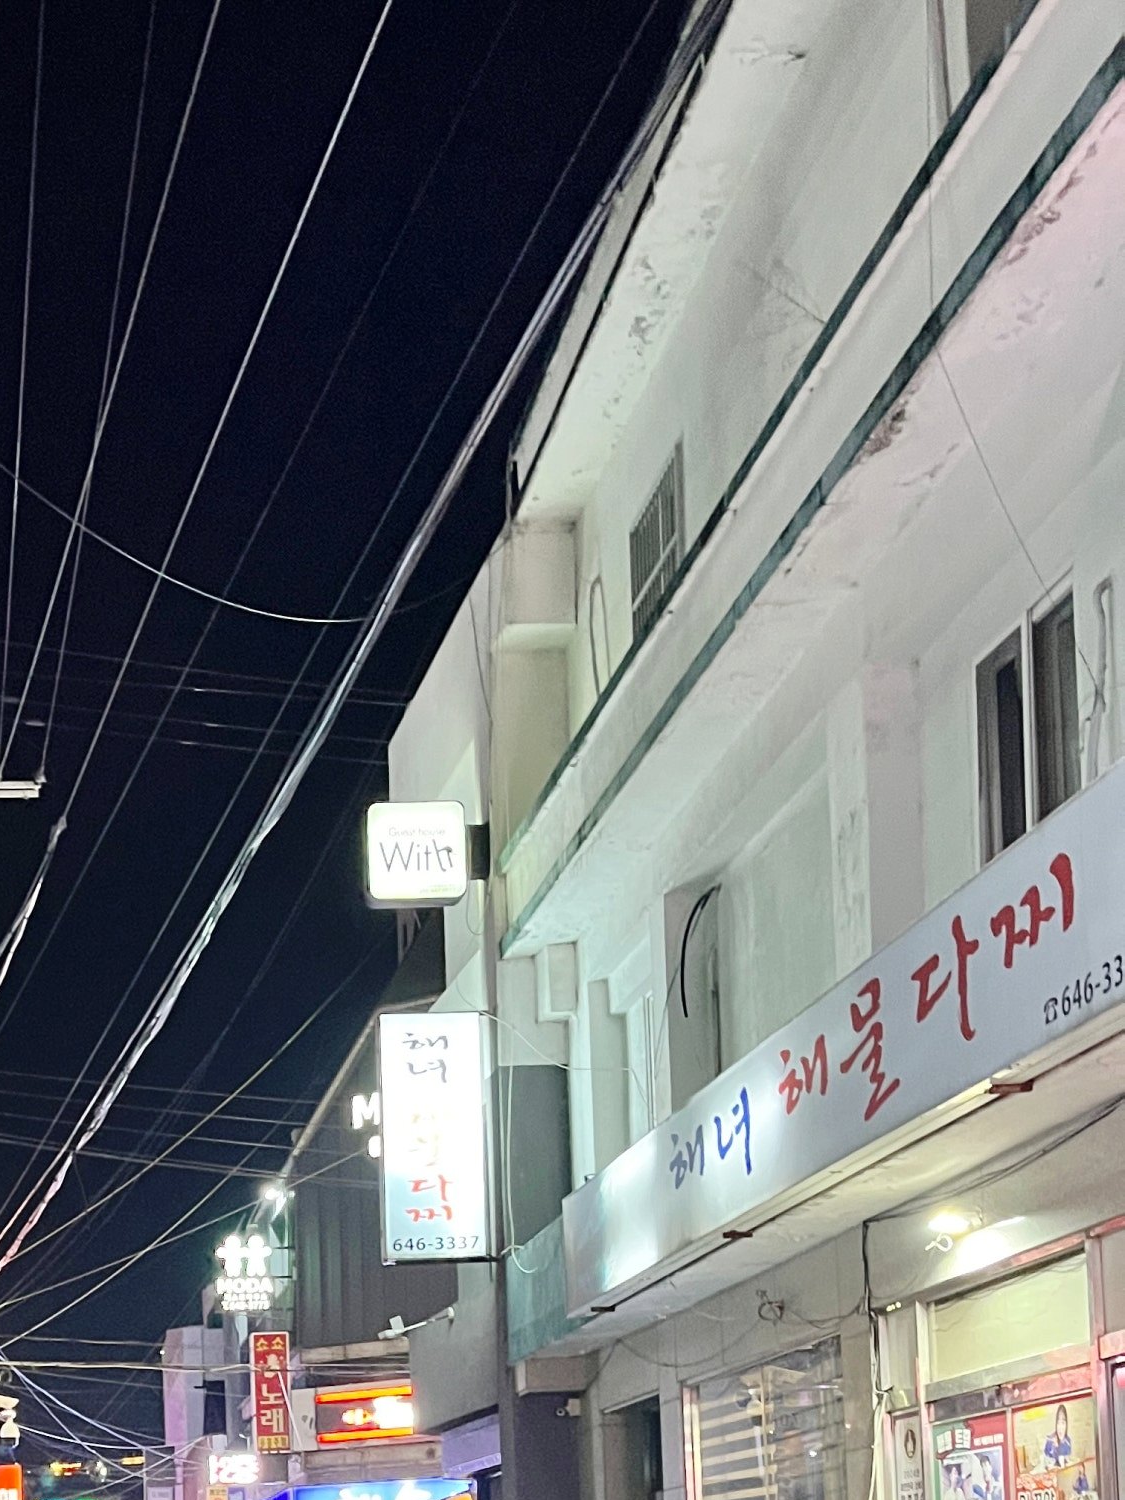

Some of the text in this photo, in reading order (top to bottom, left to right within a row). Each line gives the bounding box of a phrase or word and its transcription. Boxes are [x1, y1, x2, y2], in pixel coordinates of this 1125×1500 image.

[378, 838, 454, 873] With
[402, 1032, 450, 1084] 해녀
[669, 1086, 752, 1190] 해녀
[392, 1235, 480, 1252] 646-3337
[259, 1383, 285, 1434] 노래
